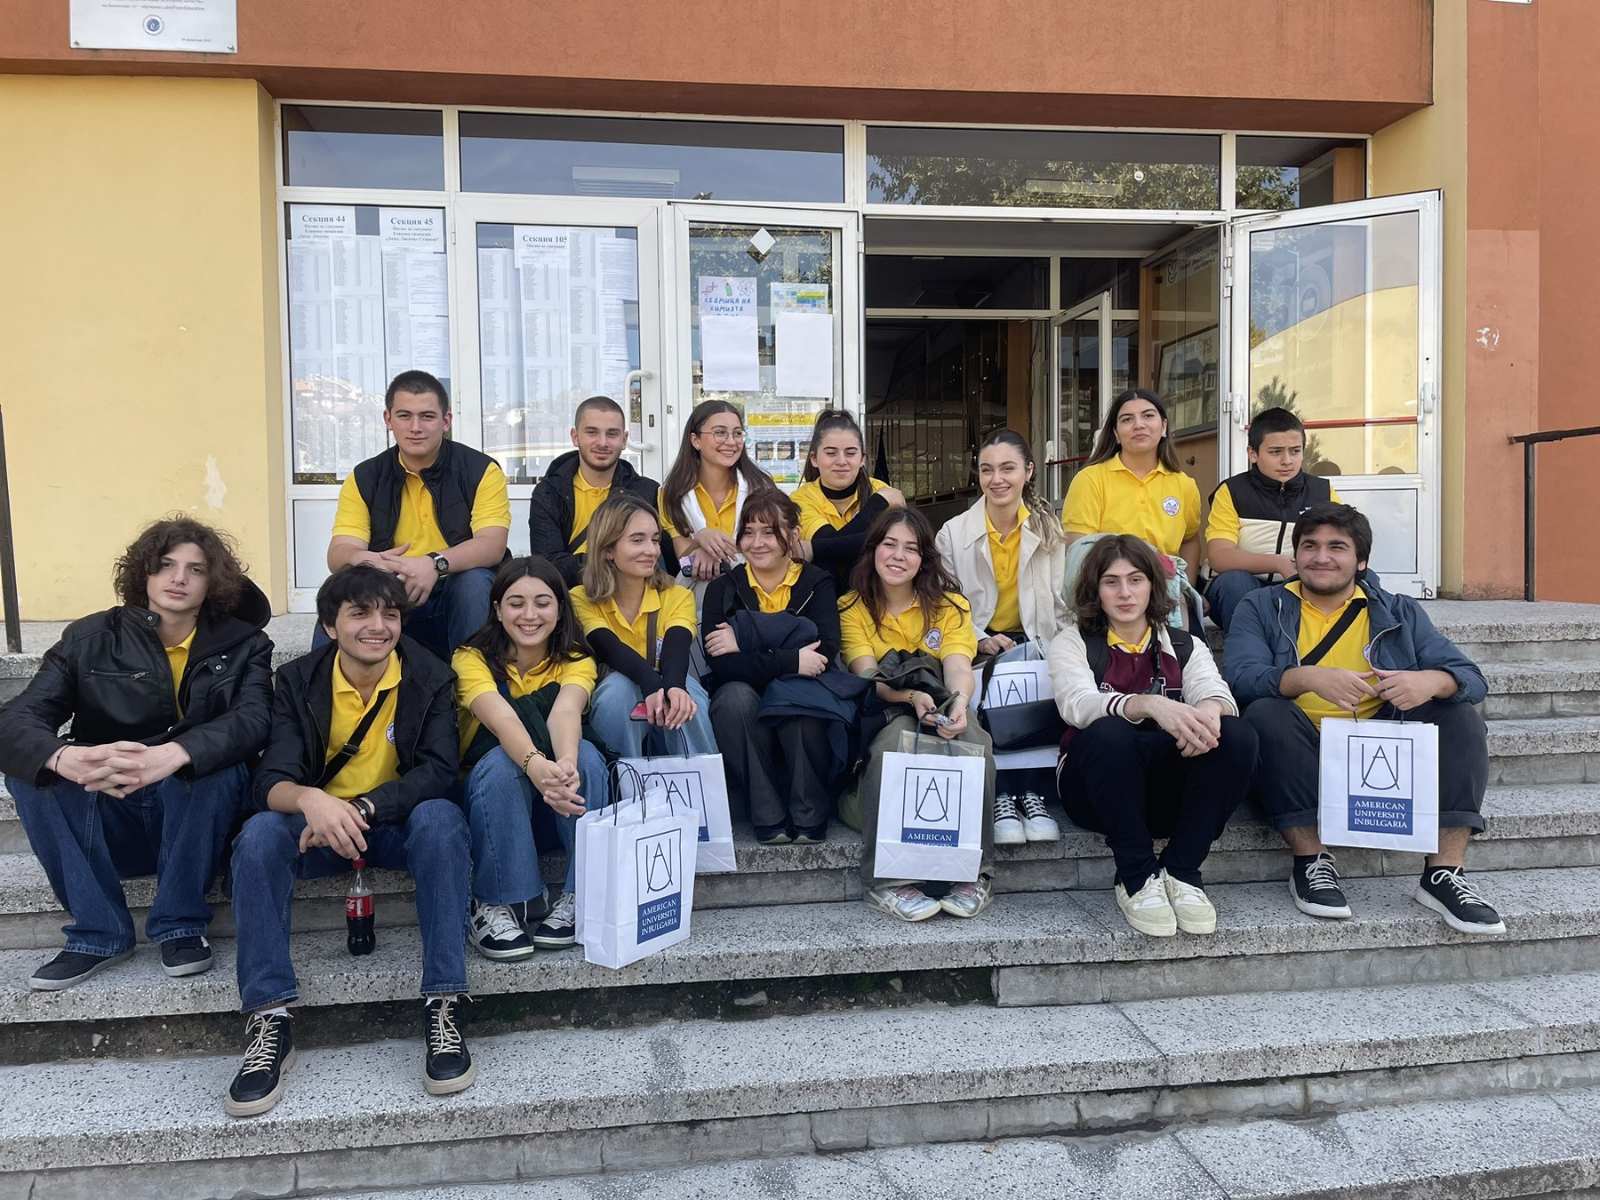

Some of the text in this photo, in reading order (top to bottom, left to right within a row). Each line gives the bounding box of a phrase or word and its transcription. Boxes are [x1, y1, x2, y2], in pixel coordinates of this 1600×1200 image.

[302, 214, 346, 223] Секция 44
[390, 217, 433, 226] Секция 45
[522, 234, 553, 243] Секция
[1354, 800, 1405, 810] AMERICAN
[1354, 809, 1407, 820] UNIVERSITY
[907, 832, 952, 842] AMERICAN
[642, 899, 677, 916] AMERICAN
[642, 908, 677, 927] UNIVERSITY
